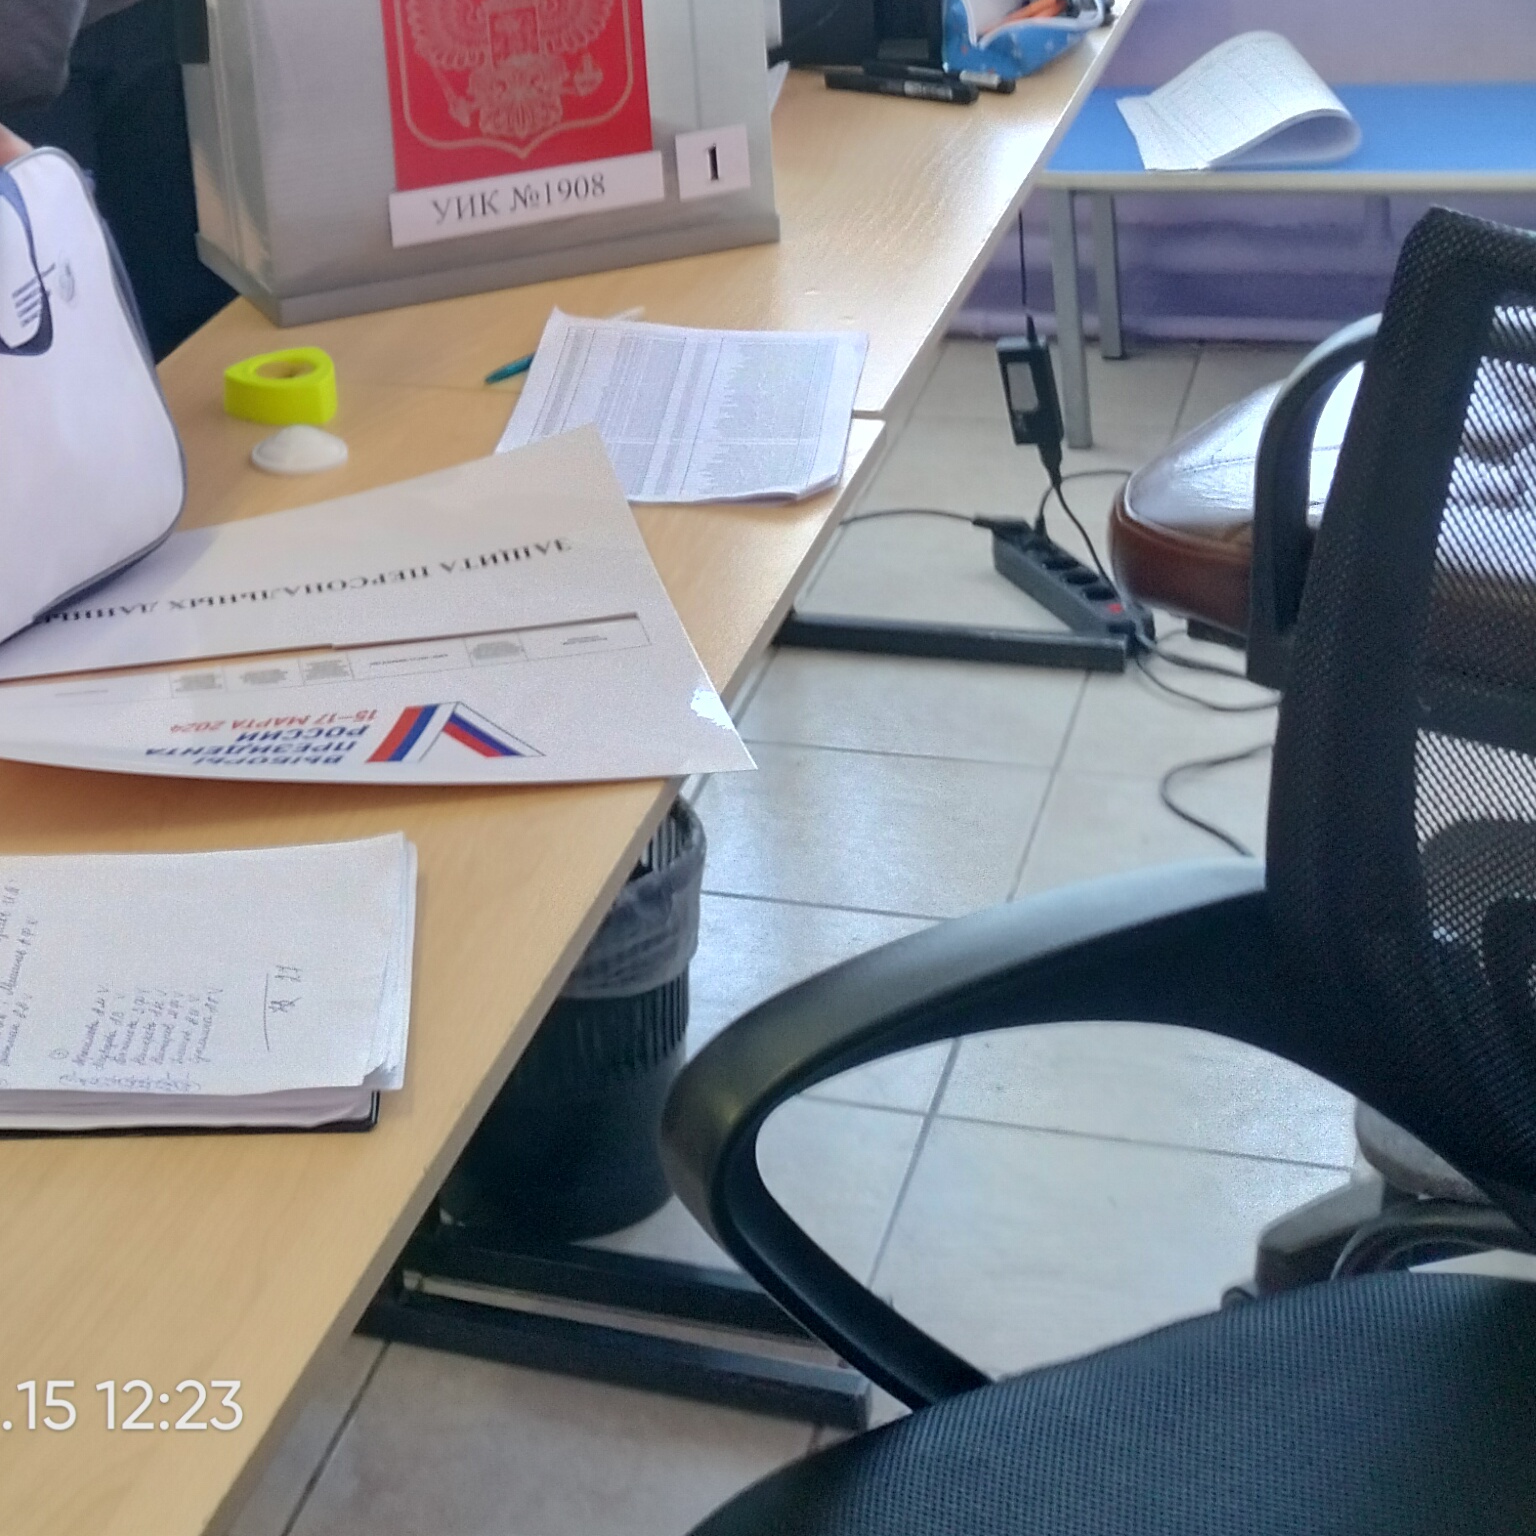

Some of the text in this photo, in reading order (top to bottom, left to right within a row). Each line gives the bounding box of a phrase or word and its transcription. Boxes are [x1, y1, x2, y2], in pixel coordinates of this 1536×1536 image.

[704, 143, 720, 182] 1
[432, 173, 606, 224] УИК №1908
[439, 538, 571, 573] ЗАЩИТА
[169, 566, 429, 609] ПЕРСОНАЛЬНЫХ
[232, 715, 306, 731] МАРТА
[237, 725, 370, 742] РОССИИ
[145, 740, 357, 757] ПРЕЗИДЕНТА
